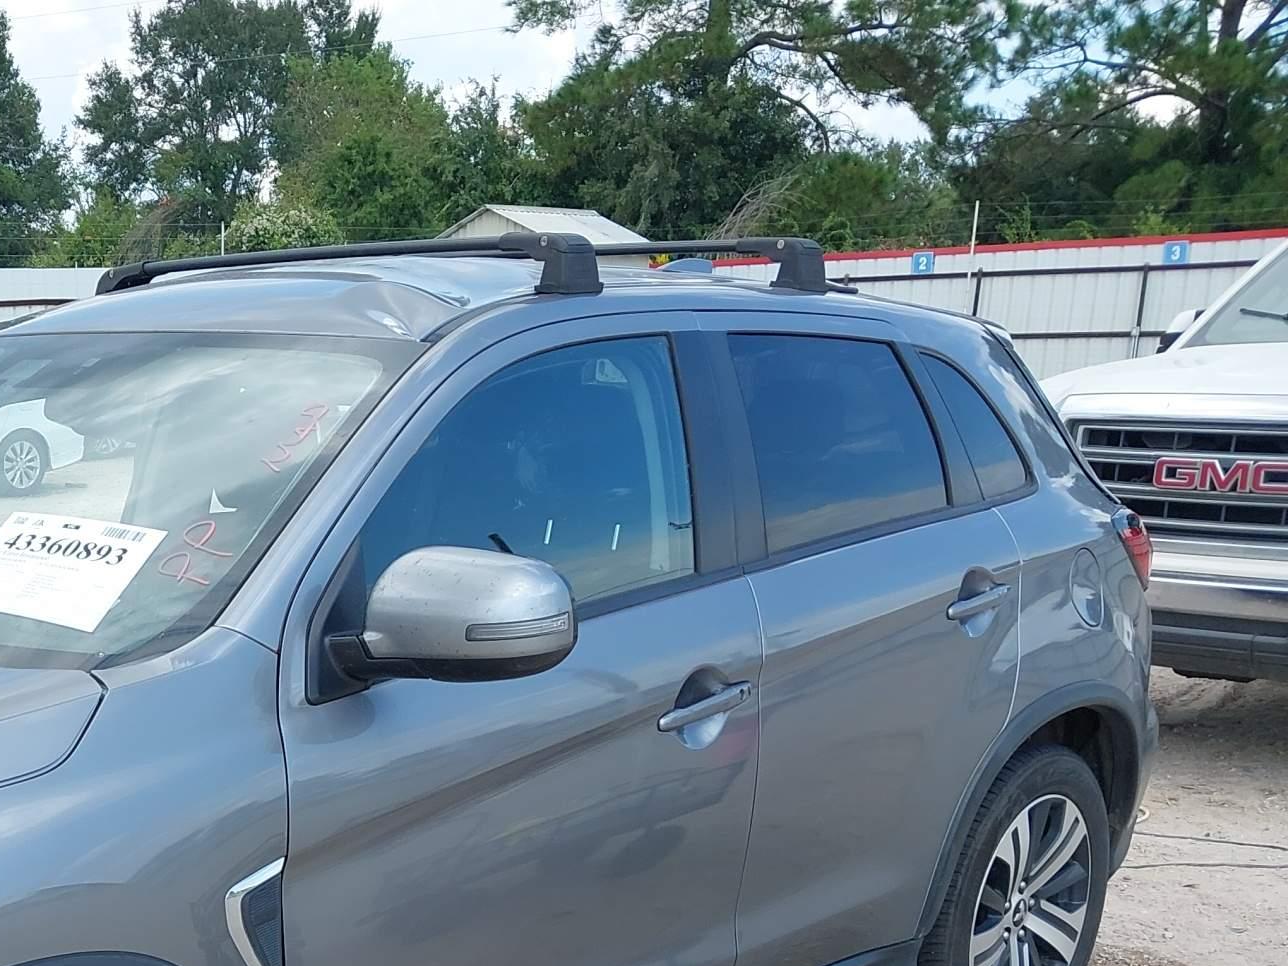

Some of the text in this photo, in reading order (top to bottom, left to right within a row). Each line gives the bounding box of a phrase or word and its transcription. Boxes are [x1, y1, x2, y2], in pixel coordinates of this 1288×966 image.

[918, 256, 928, 271] 2
[1170, 244, 1181, 260] 3
[1153, 457, 1288, 494] GMC
[3, 532, 129, 566] 43360893
